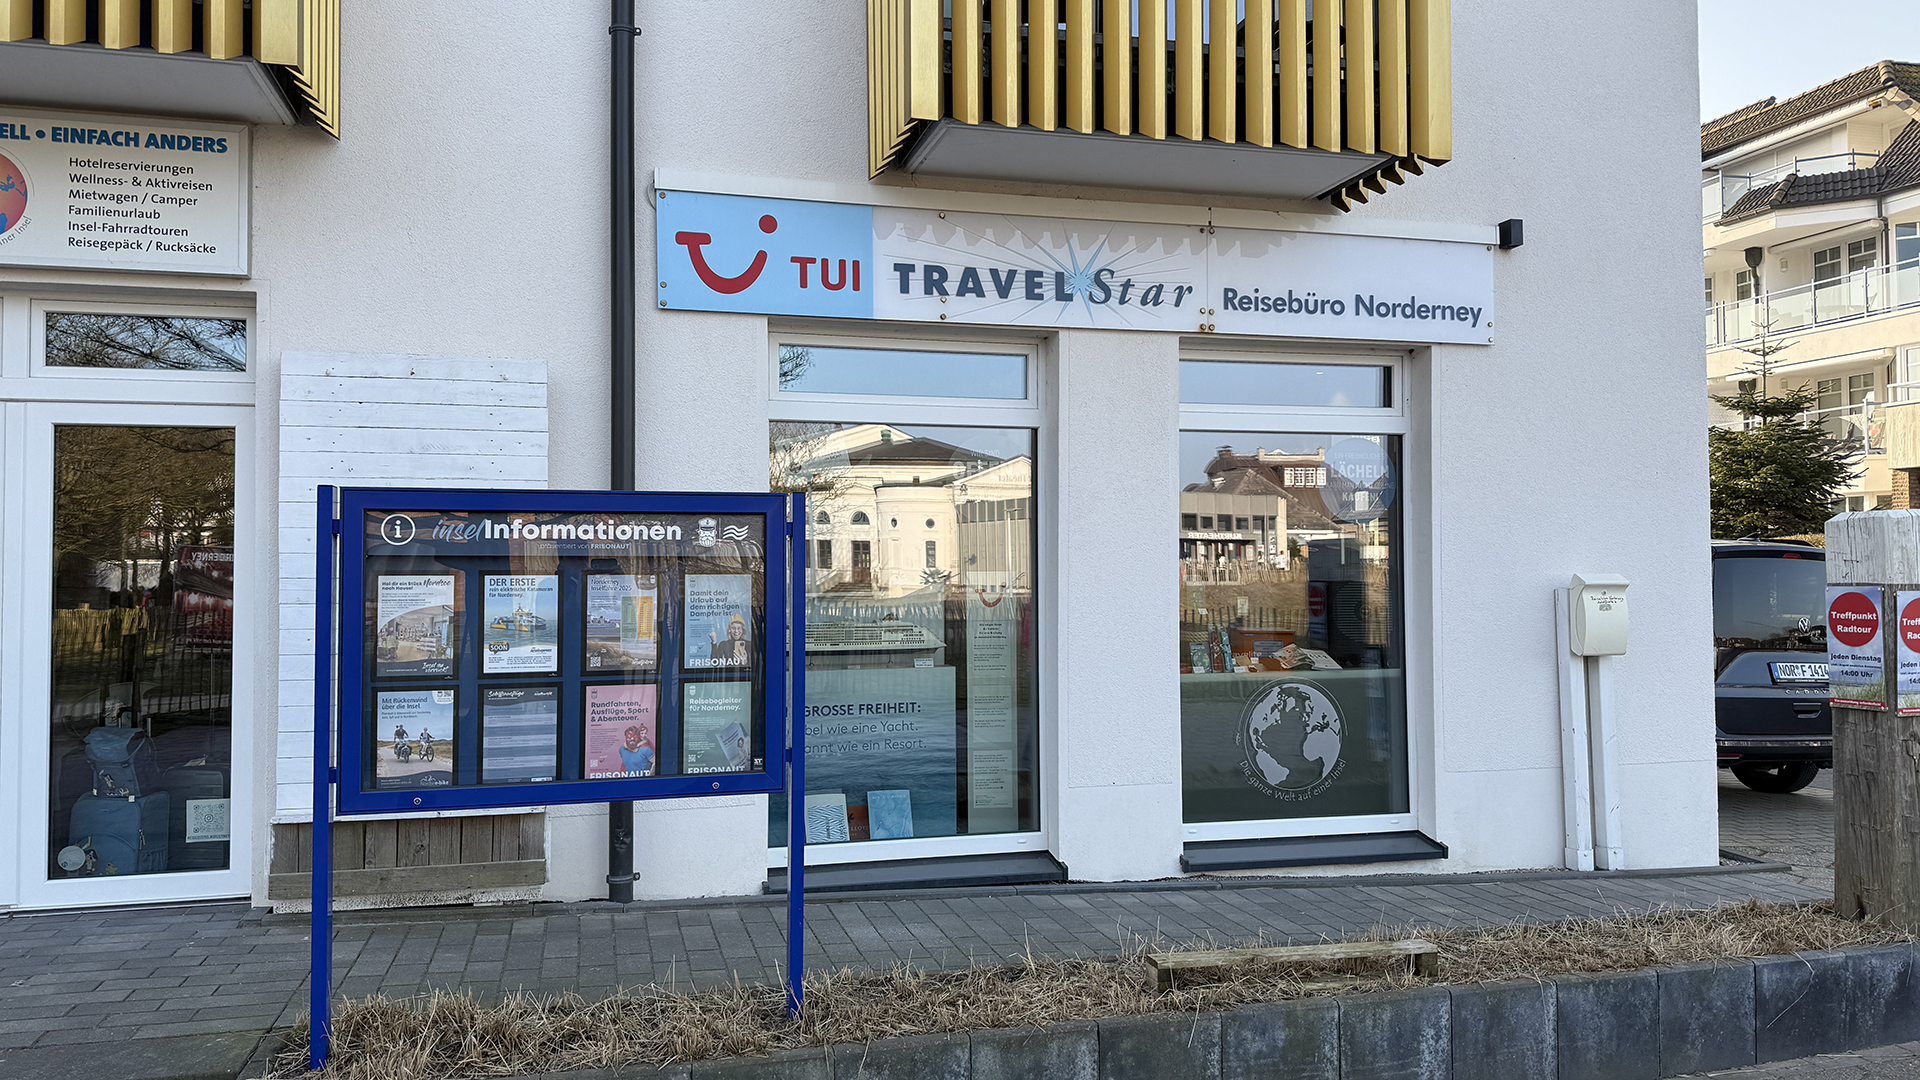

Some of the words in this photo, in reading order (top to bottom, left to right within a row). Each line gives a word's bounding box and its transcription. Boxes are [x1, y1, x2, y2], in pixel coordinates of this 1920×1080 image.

[51, 126, 140, 148] EINFACH
[144, 133, 228, 154] ANDERS
[69, 157, 194, 175] Hotelreservierungen
[69, 173, 128, 185] Wellness-
[131, 177, 142, 187] &
[146, 178, 213, 192] Aktivreisen
[68, 190, 138, 204] Mietwagen
[151, 194, 198, 207] Camper
[68, 205, 161, 220] Familienurlaub
[14, 215, 32, 235] Insel
[68, 221, 189, 237] Insel-Fahrradtouren
[68, 237, 143, 251] Reisegepäck
[155, 241, 217, 254] Rucksäcke
[790, 256, 861, 292] TUI
[893, 262, 1074, 302] TRAVEL
[1088, 268, 1194, 308] Star
[1222, 287, 1346, 317] Reisebüro
[1354, 293, 1483, 328] Norderney
[1331, 461, 1390, 478] LÄCHELN
[489, 578, 507, 586] DER
[510, 578, 536, 586] ERSTE
[690, 610, 722, 618] Dampfer
[707, 603, 740, 611] richtigen
[1831, 611, 1877, 621] Treffpunkt
[1837, 625, 1872, 634] Radtour
[1830, 653, 1849, 661] jeden
[1851, 654, 1882, 663] Dienstag
[1900, 661, 1918, 669] jeden
[1778, 664, 1798, 677] NOR
[1800, 665, 1806, 677] F
[1840, 669, 1859, 677] 14:00
[393, 696, 428, 704] Rückenwind
[590, 700, 642, 708] Rundfahrten,
[689, 697, 742, 705] Reisebegleiter
[590, 708, 627, 716] Ausflüge,
[627, 707, 649, 715] Sport
[701, 704, 741, 712] Norderney.
[804, 704, 854, 717] GROSSE
[858, 702, 922, 715] FREIHEIT:
[827, 723, 848, 735] wie
[851, 722, 877, 734] eine
[880, 720, 919, 732] Yacht.
[837, 741, 860, 752] wie
[863, 740, 880, 751] ein
[884, 738, 927, 750] Resort.
[1239, 759, 1251, 778] Die
[1247, 774, 1272, 797] ganze
[1274, 791, 1296, 801] Welt
[1297, 790, 1312, 801] auf
[1313, 778, 1333, 797] einer
[1331, 757, 1348, 779] Insel
